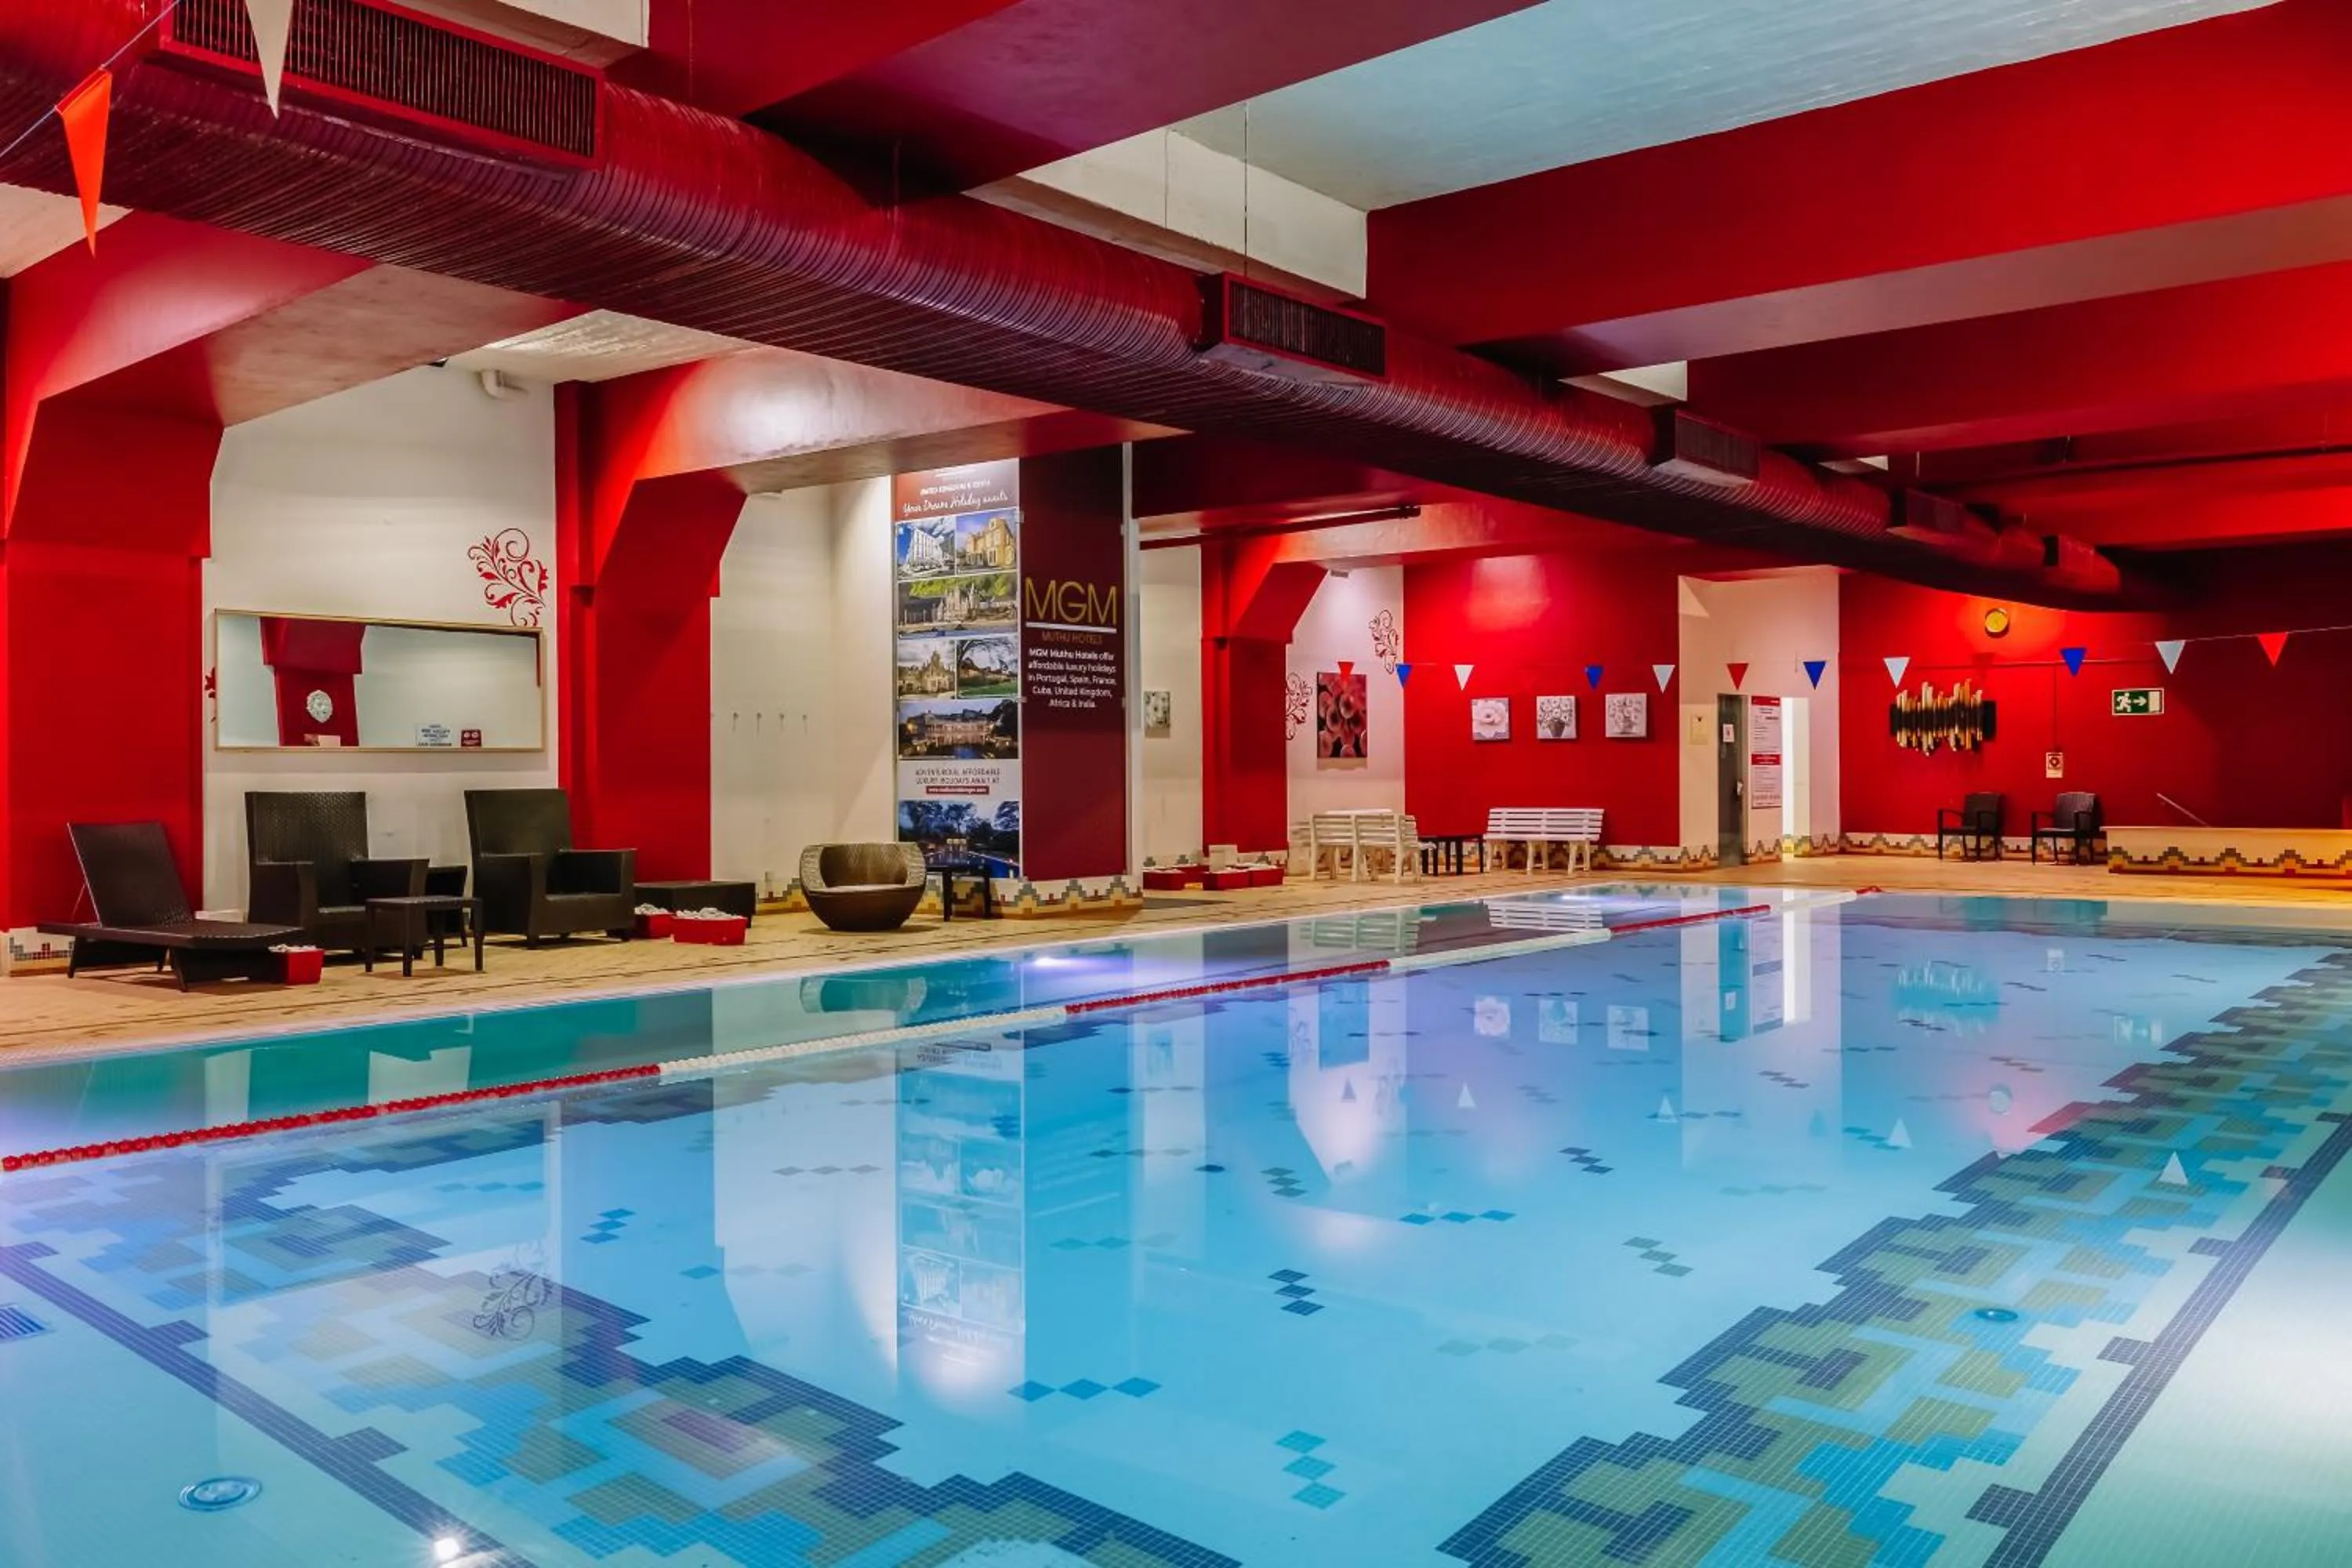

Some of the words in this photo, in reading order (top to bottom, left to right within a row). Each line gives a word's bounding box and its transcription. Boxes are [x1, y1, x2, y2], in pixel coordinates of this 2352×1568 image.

[902, 503, 921, 517] Your
[924, 499, 948, 512] Dream
[949, 492, 981, 510] Holiday
[1025, 576, 1116, 626] MGM
[1029, 648, 1048, 657] MGM
[1050, 648, 1074, 659] Muthu
[1075, 650, 1098, 659] Hotels
[1098, 652, 1114, 661] offer
[1028, 659, 1065, 670] affordable
[1066, 662, 1087, 673] luxury
[1088, 663, 1116, 674] holidays
[1028, 673, 1035, 681] in
[1092, 675, 1117, 685] France,
[1054, 686, 1078, 695] United
[1080, 688, 1112, 698] Kingdom,
[1048, 699, 1070, 708] Africa
[1071, 699, 1076, 708] &
